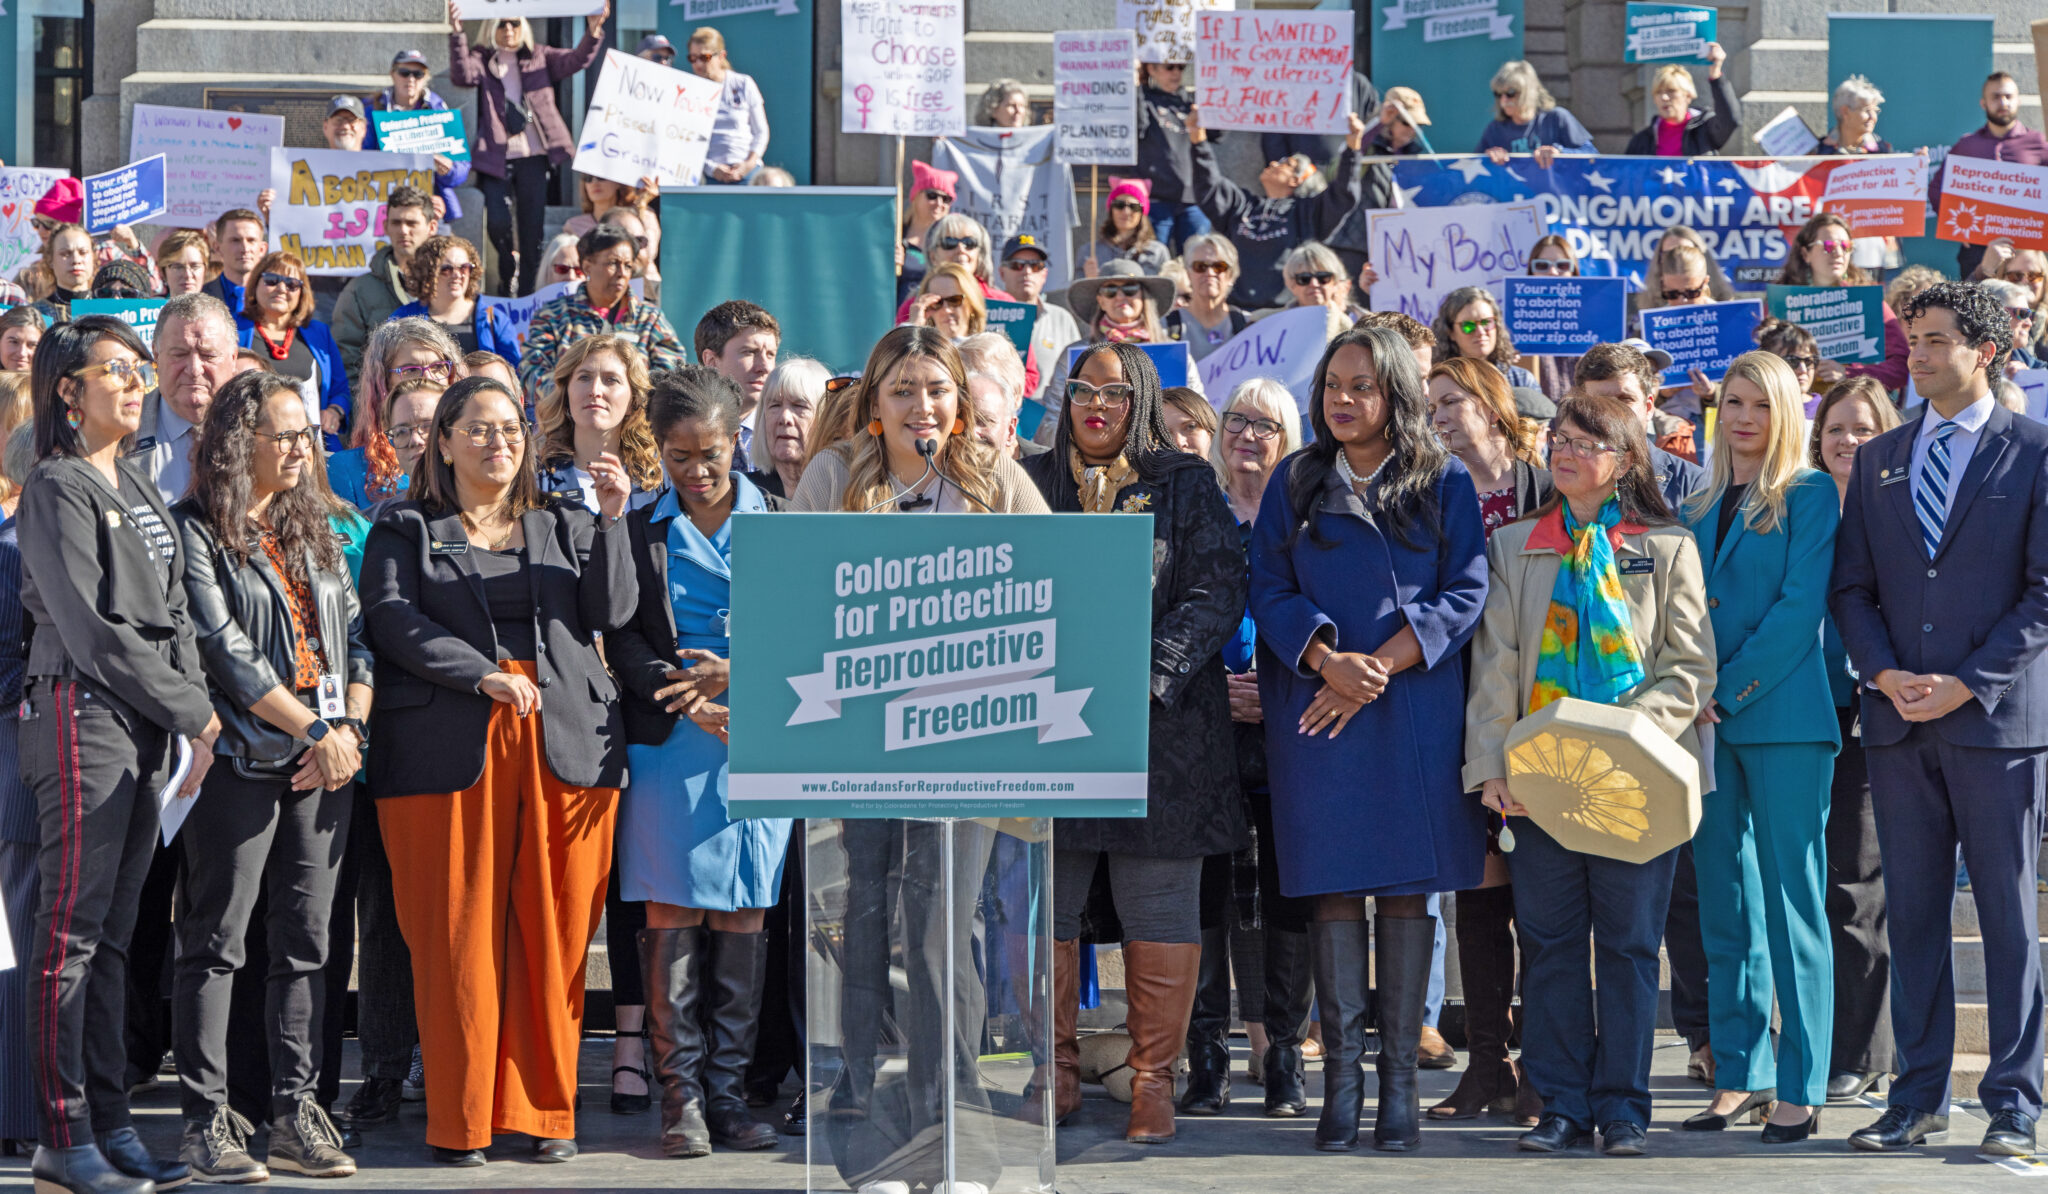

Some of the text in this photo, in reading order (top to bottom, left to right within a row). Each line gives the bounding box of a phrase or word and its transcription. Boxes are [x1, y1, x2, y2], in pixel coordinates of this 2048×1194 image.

[914, 18, 935, 37] to
[1432, 17, 1490, 37] Freedom
[1630, 12, 1672, 28] Colorado
[1201, 16, 1337, 44] If I WANTED
[871, 36, 956, 66] Choose
[1060, 40, 1129, 52] GIRLS JUST
[1059, 60, 1129, 70] WANNA HAVE
[1201, 64, 1217, 78] in
[1230, 66, 1254, 81] my
[907, 85, 944, 108] free
[1062, 81, 1127, 95] FUNDING
[1239, 87, 1288, 108] FUCK
[1304, 90, 1323, 108] A
[1085, 103, 1104, 113] FOR
[1061, 124, 1129, 138] PLANNED
[1058, 147, 1130, 157] PARENTHOOD
[92, 169, 137, 191] Your right
[1832, 165, 1896, 183] Reproductive
[1952, 165, 2041, 185] Reproductive
[92, 180, 138, 200] to abortion
[1862, 181, 1879, 189] for
[1882, 178, 1898, 188] All
[1950, 179, 2042, 199] Justice for All
[92, 189, 136, 208] should not
[92, 198, 136, 217] depend on
[92, 215, 116, 228] your
[117, 209, 130, 220] zip
[130, 200, 149, 214] code
[1513, 193, 1735, 227] ONGMONT
[1852, 205, 1904, 220] progressive
[1852, 217, 1904, 230] promotions
[1984, 213, 2044, 229] progressive
[1983, 224, 2043, 239] promotions
[1566, 228, 1787, 261] DEMORATS
[1384, 228, 1434, 288] My
[1737, 269, 1762, 280] NOT
[1515, 282, 1582, 297] Your right
[1514, 297, 1582, 307] to abortion
[1785, 289, 1848, 308] Coloradans
[1514, 309, 1578, 319] should not
[1653, 309, 1718, 327] Your right
[1786, 300, 1863, 322] for Protecting
[1514, 320, 1579, 332] depend on
[1653, 324, 1719, 340] to abortion
[1809, 319, 1860, 337] roductive
[1512, 330, 1599, 345] your zip code
[1653, 336, 1717, 351] should not
[1672, 348, 1718, 362] pend on
[1821, 340, 1859, 357] eedom
[835, 543, 1013, 597] Coloradans
[834, 578, 1053, 639] for Protecting
[835, 629, 1044, 690] Reproductive
[903, 692, 1038, 740] Freedom
[801, 780, 1075, 794] www.ColoradansForReproductiveFreedom.com
[928, 802, 958, 810] Protecting
